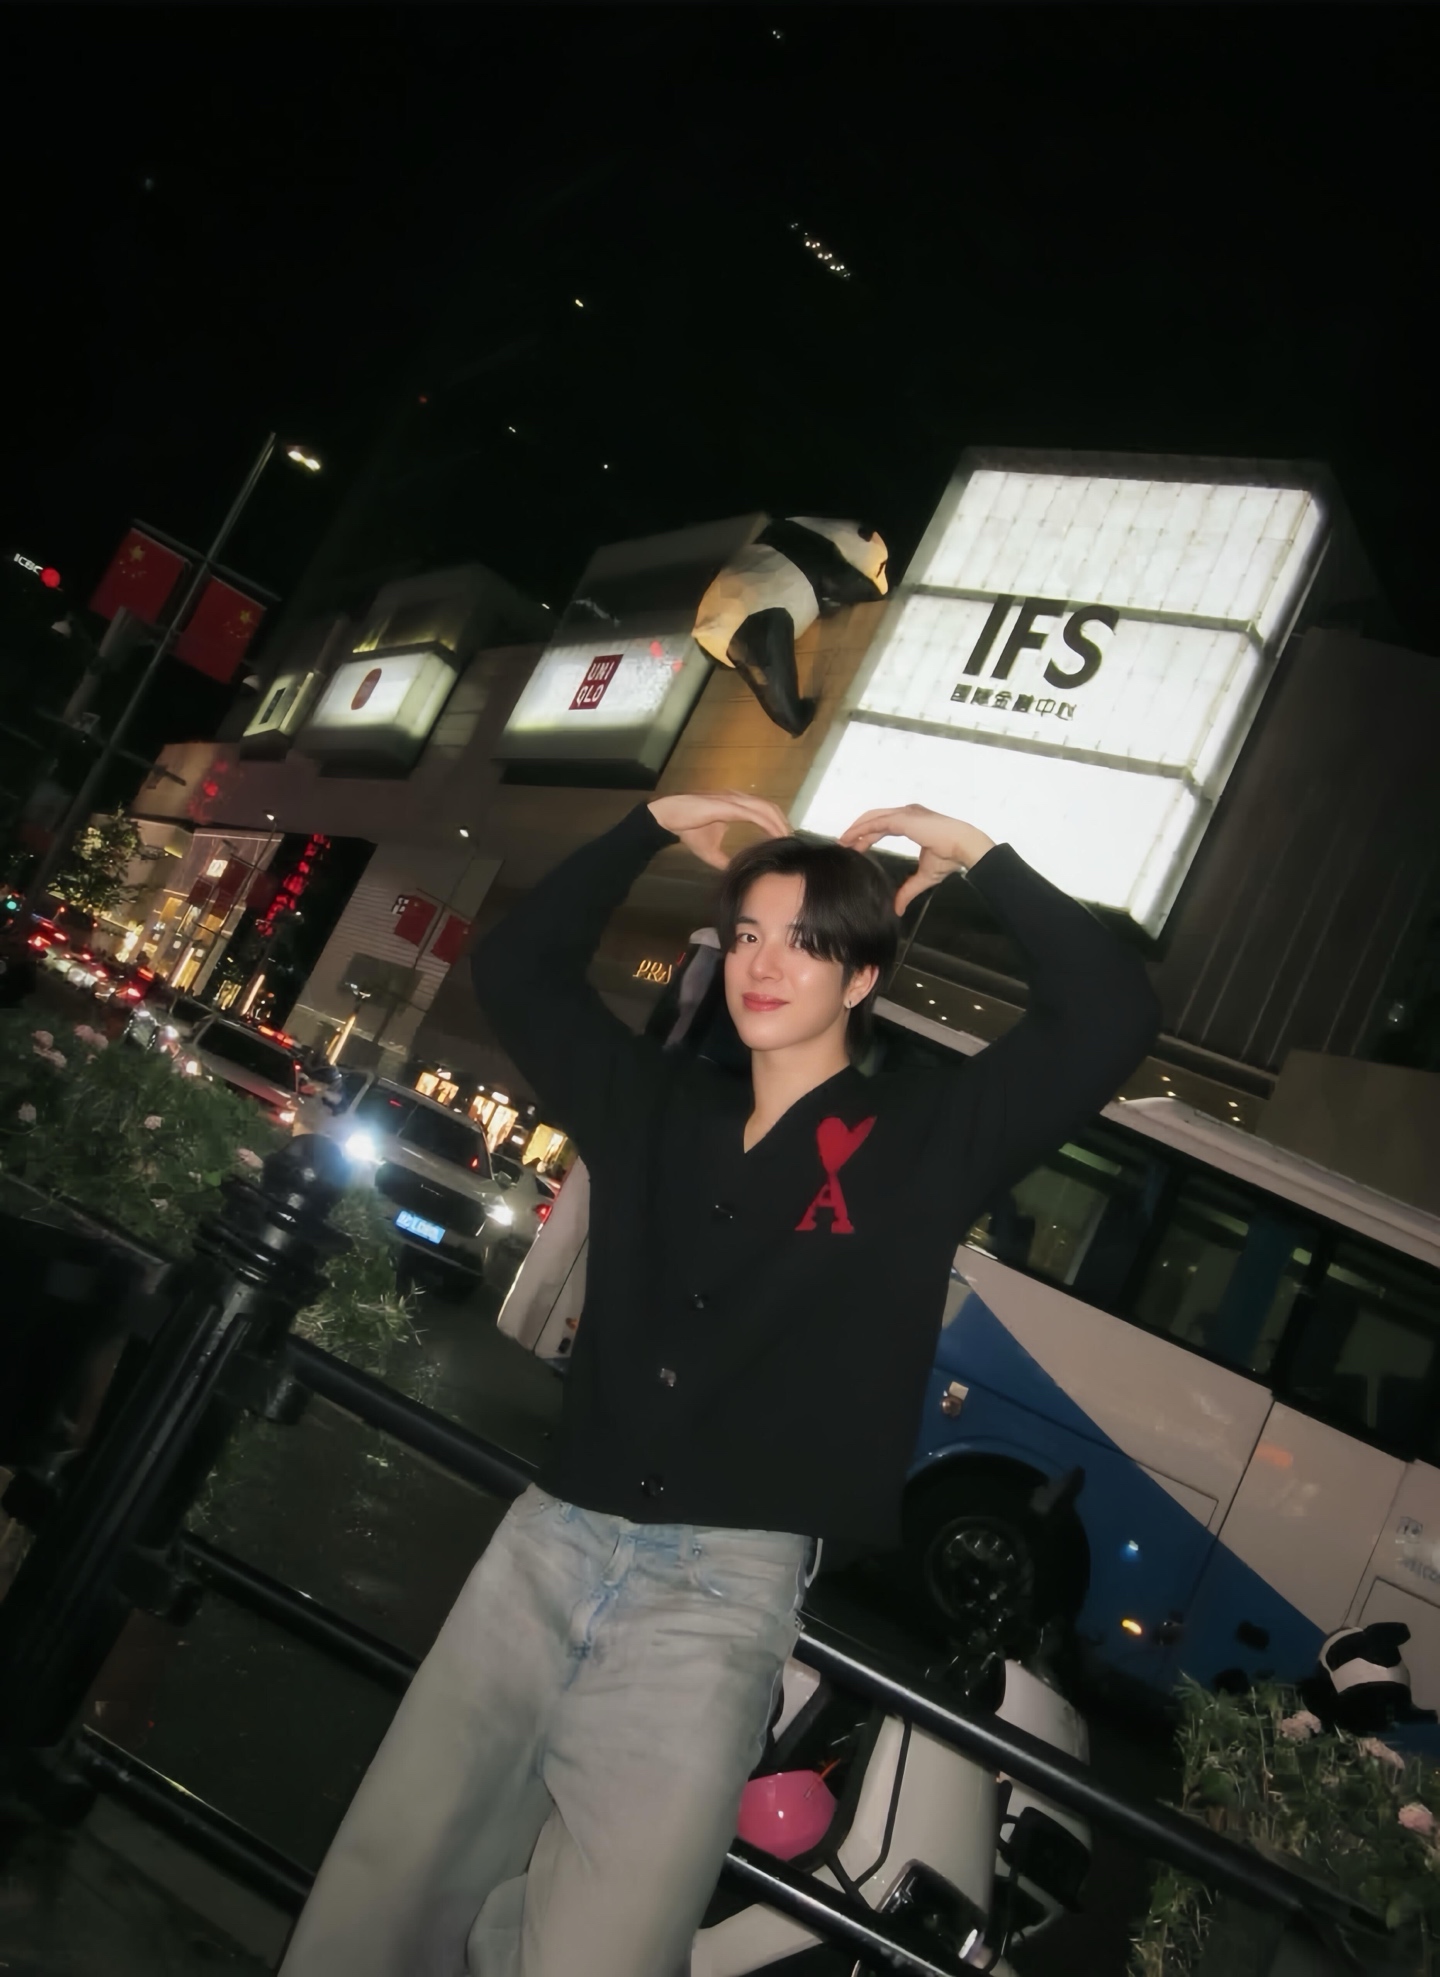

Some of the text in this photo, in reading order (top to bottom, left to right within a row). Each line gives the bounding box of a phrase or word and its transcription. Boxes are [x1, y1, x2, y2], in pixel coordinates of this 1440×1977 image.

[962, 593, 1120, 690] IFS
[587, 660, 616, 681] UNI
[576, 683, 605, 707] QLO
